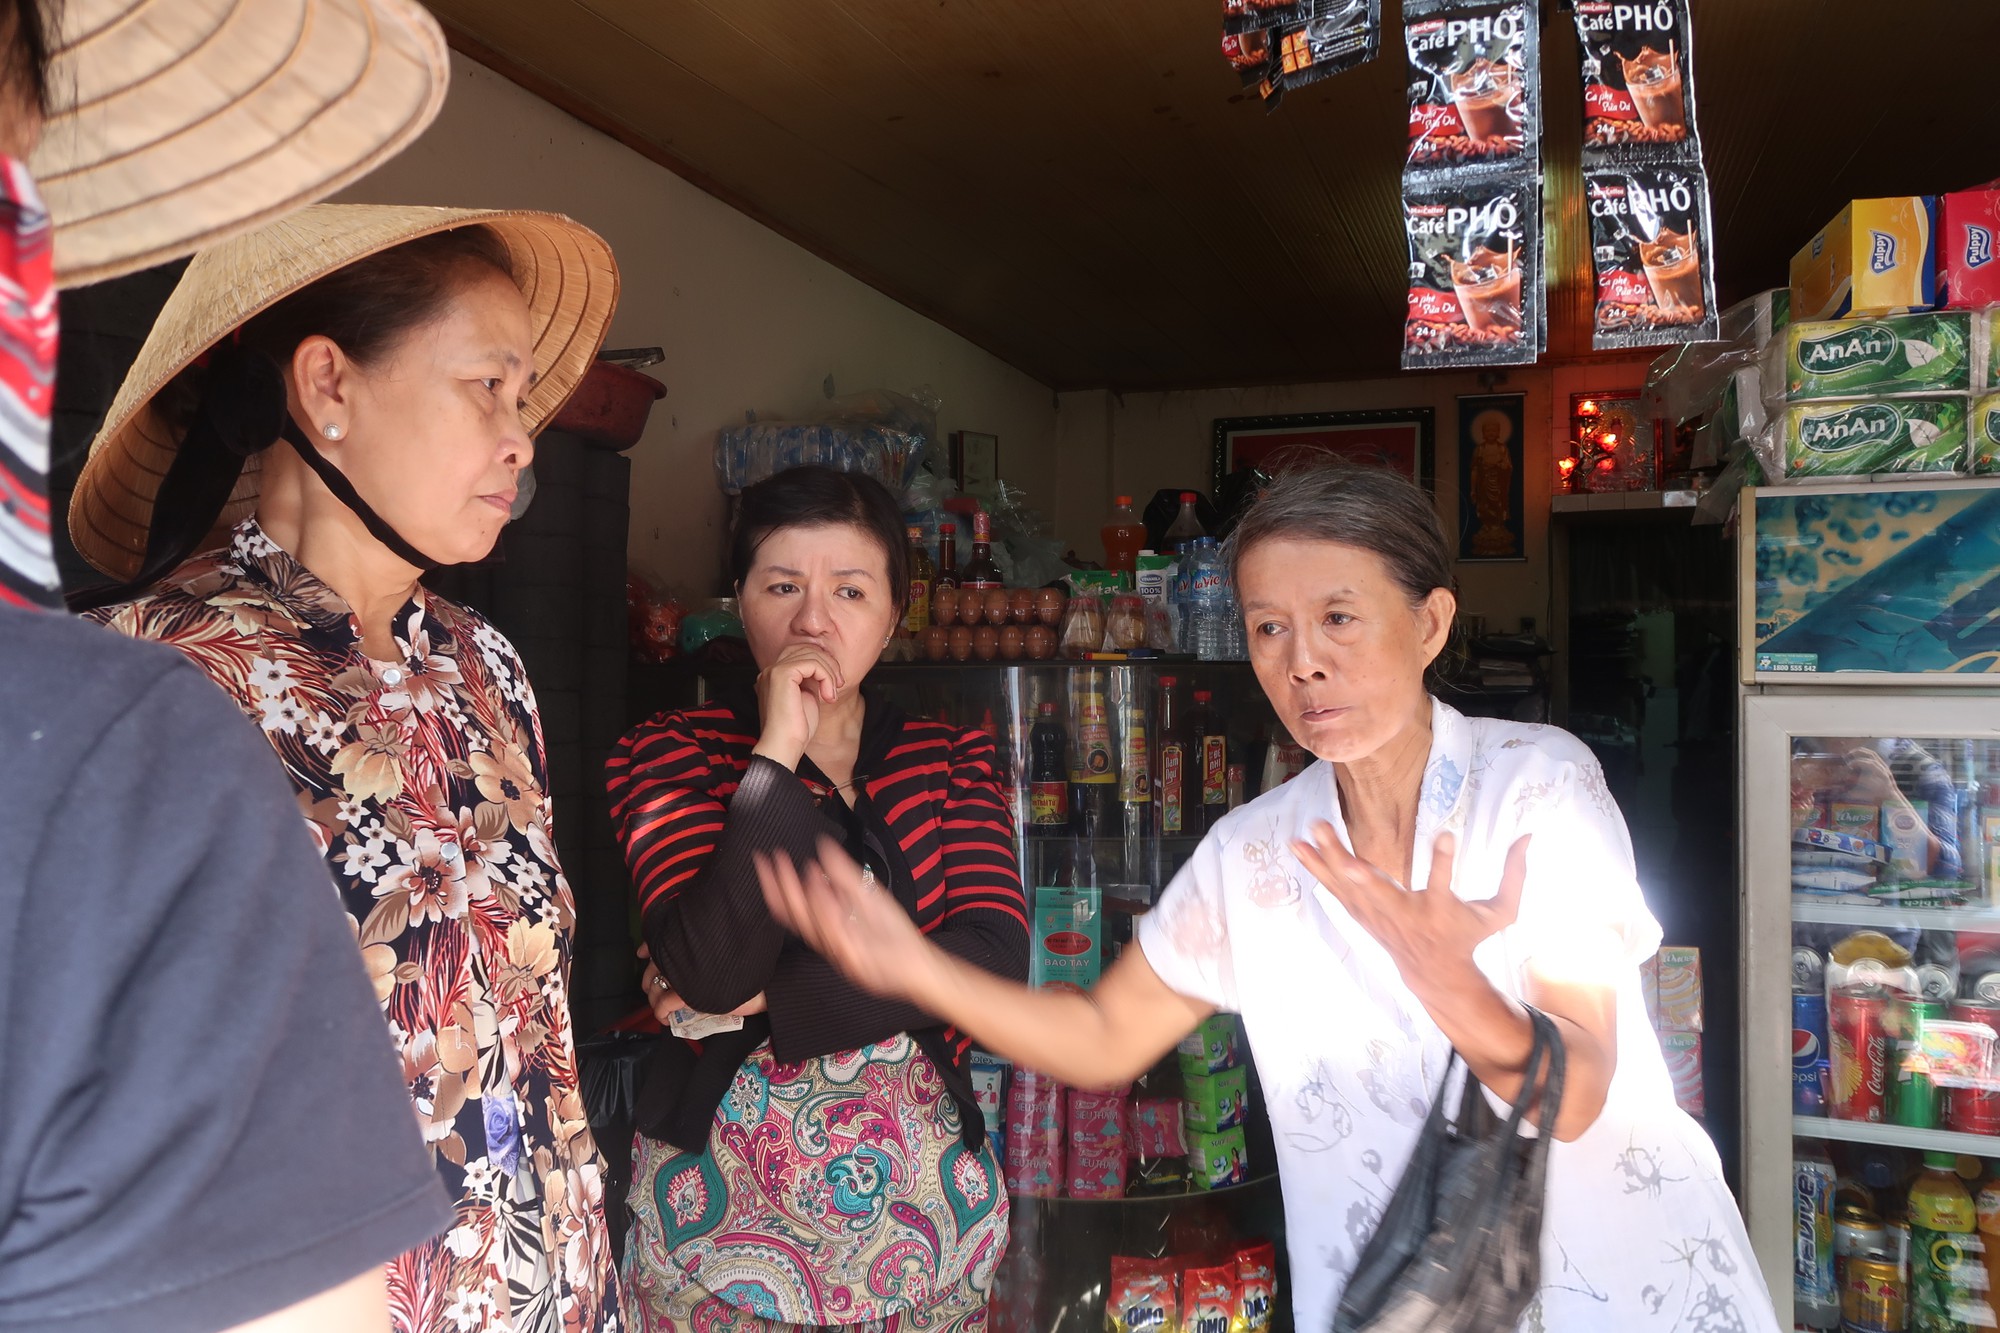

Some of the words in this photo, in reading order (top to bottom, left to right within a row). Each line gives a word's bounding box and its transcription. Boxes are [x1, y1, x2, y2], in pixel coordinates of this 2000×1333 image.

[1578, 13, 1613, 31] Café
[1408, 31, 1444, 51] Café
[1591, 197, 1627, 217] Café
[1408, 215, 1444, 234] Café
[1874, 235, 1892, 269] Pulppy
[1969, 228, 1988, 263] Pulppy
[1809, 338, 1881, 363] AnAn
[1812, 417, 1885, 442] AnAn
[1044, 958, 1067, 967] BAO
[1070, 958, 1089, 967] TAY
[1792, 1071, 1817, 1084] epsi
[1127, 1307, 1164, 1326] OMO
[1197, 1316, 1228, 1333] OMO
